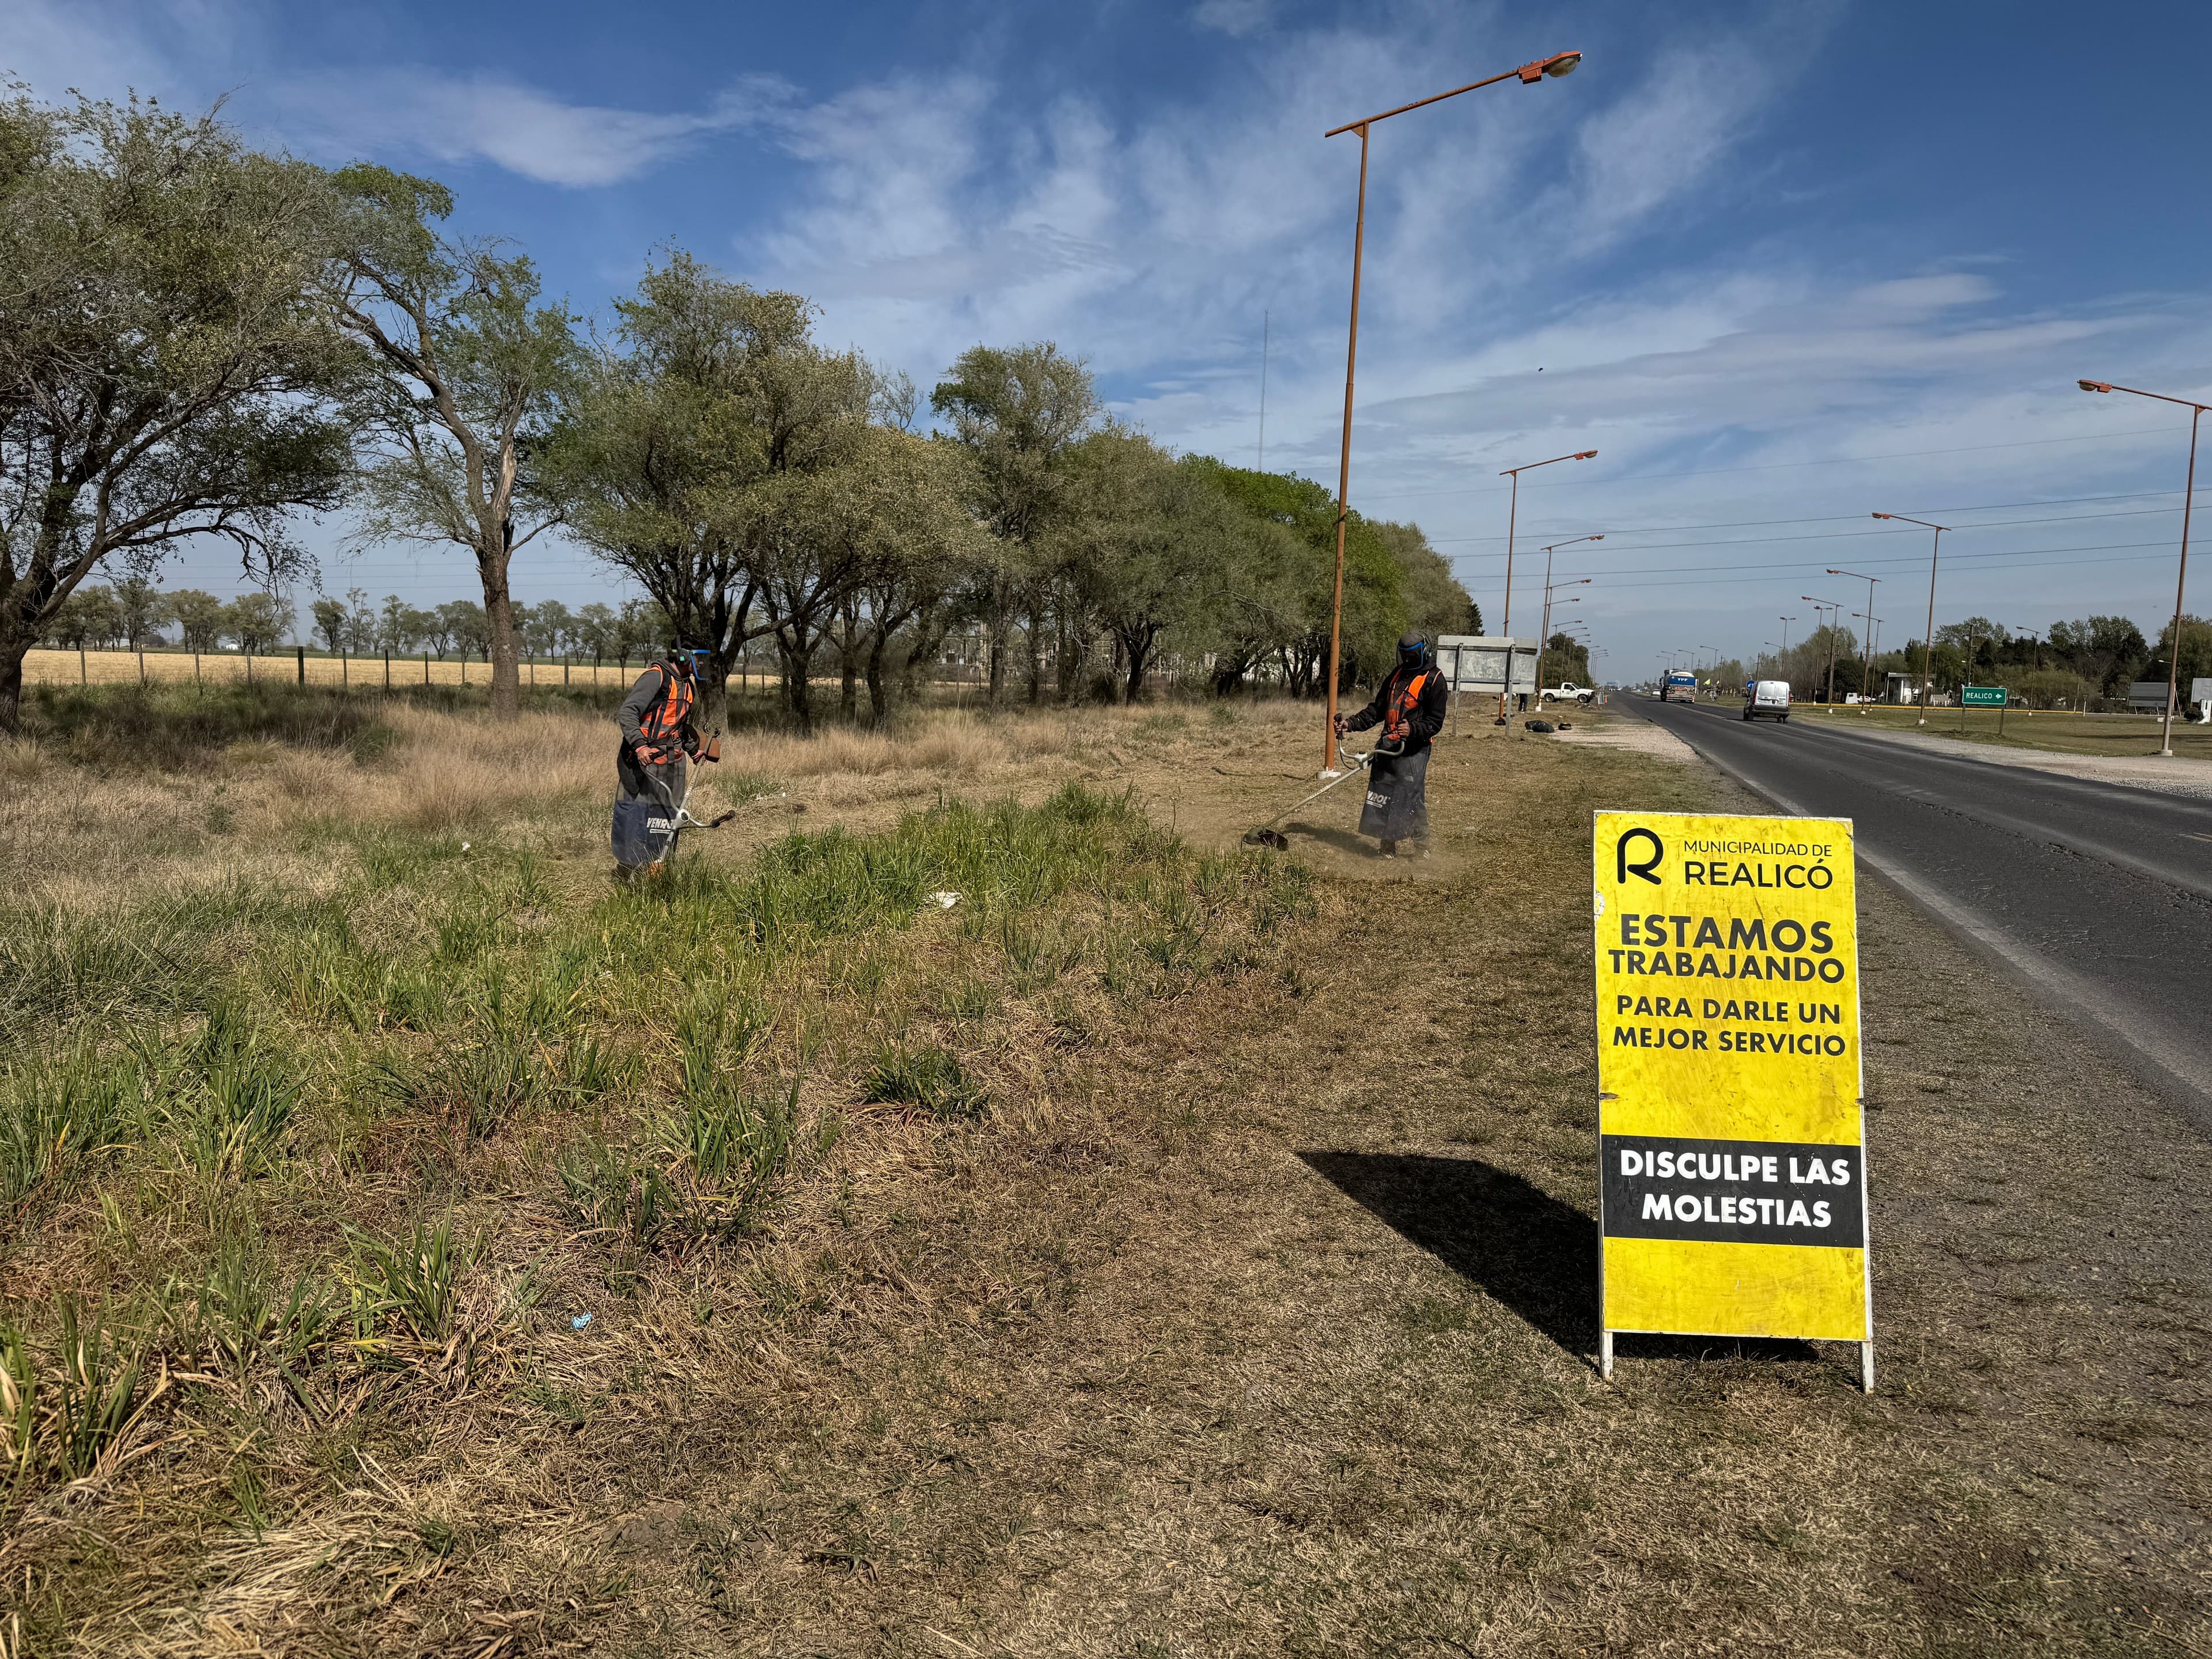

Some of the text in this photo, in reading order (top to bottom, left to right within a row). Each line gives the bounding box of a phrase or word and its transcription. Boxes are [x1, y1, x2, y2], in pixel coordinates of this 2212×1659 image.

[1684, 840, 1832, 857] MUNICIPALIDAD DE
[1685, 859, 1833, 889] REALICÓ
[1621, 914, 1834, 954] ESTAMOS
[1608, 949, 1844, 983] TRABAJANDO
[1617, 995, 1840, 1024] PARA DARLE UN
[1613, 1027, 1845, 1056] MEJOR SERVICIO
[1620, 1150, 1850, 1185] DISCULPE LAS
[1642, 1194, 1832, 1228] MOLESTIAS
